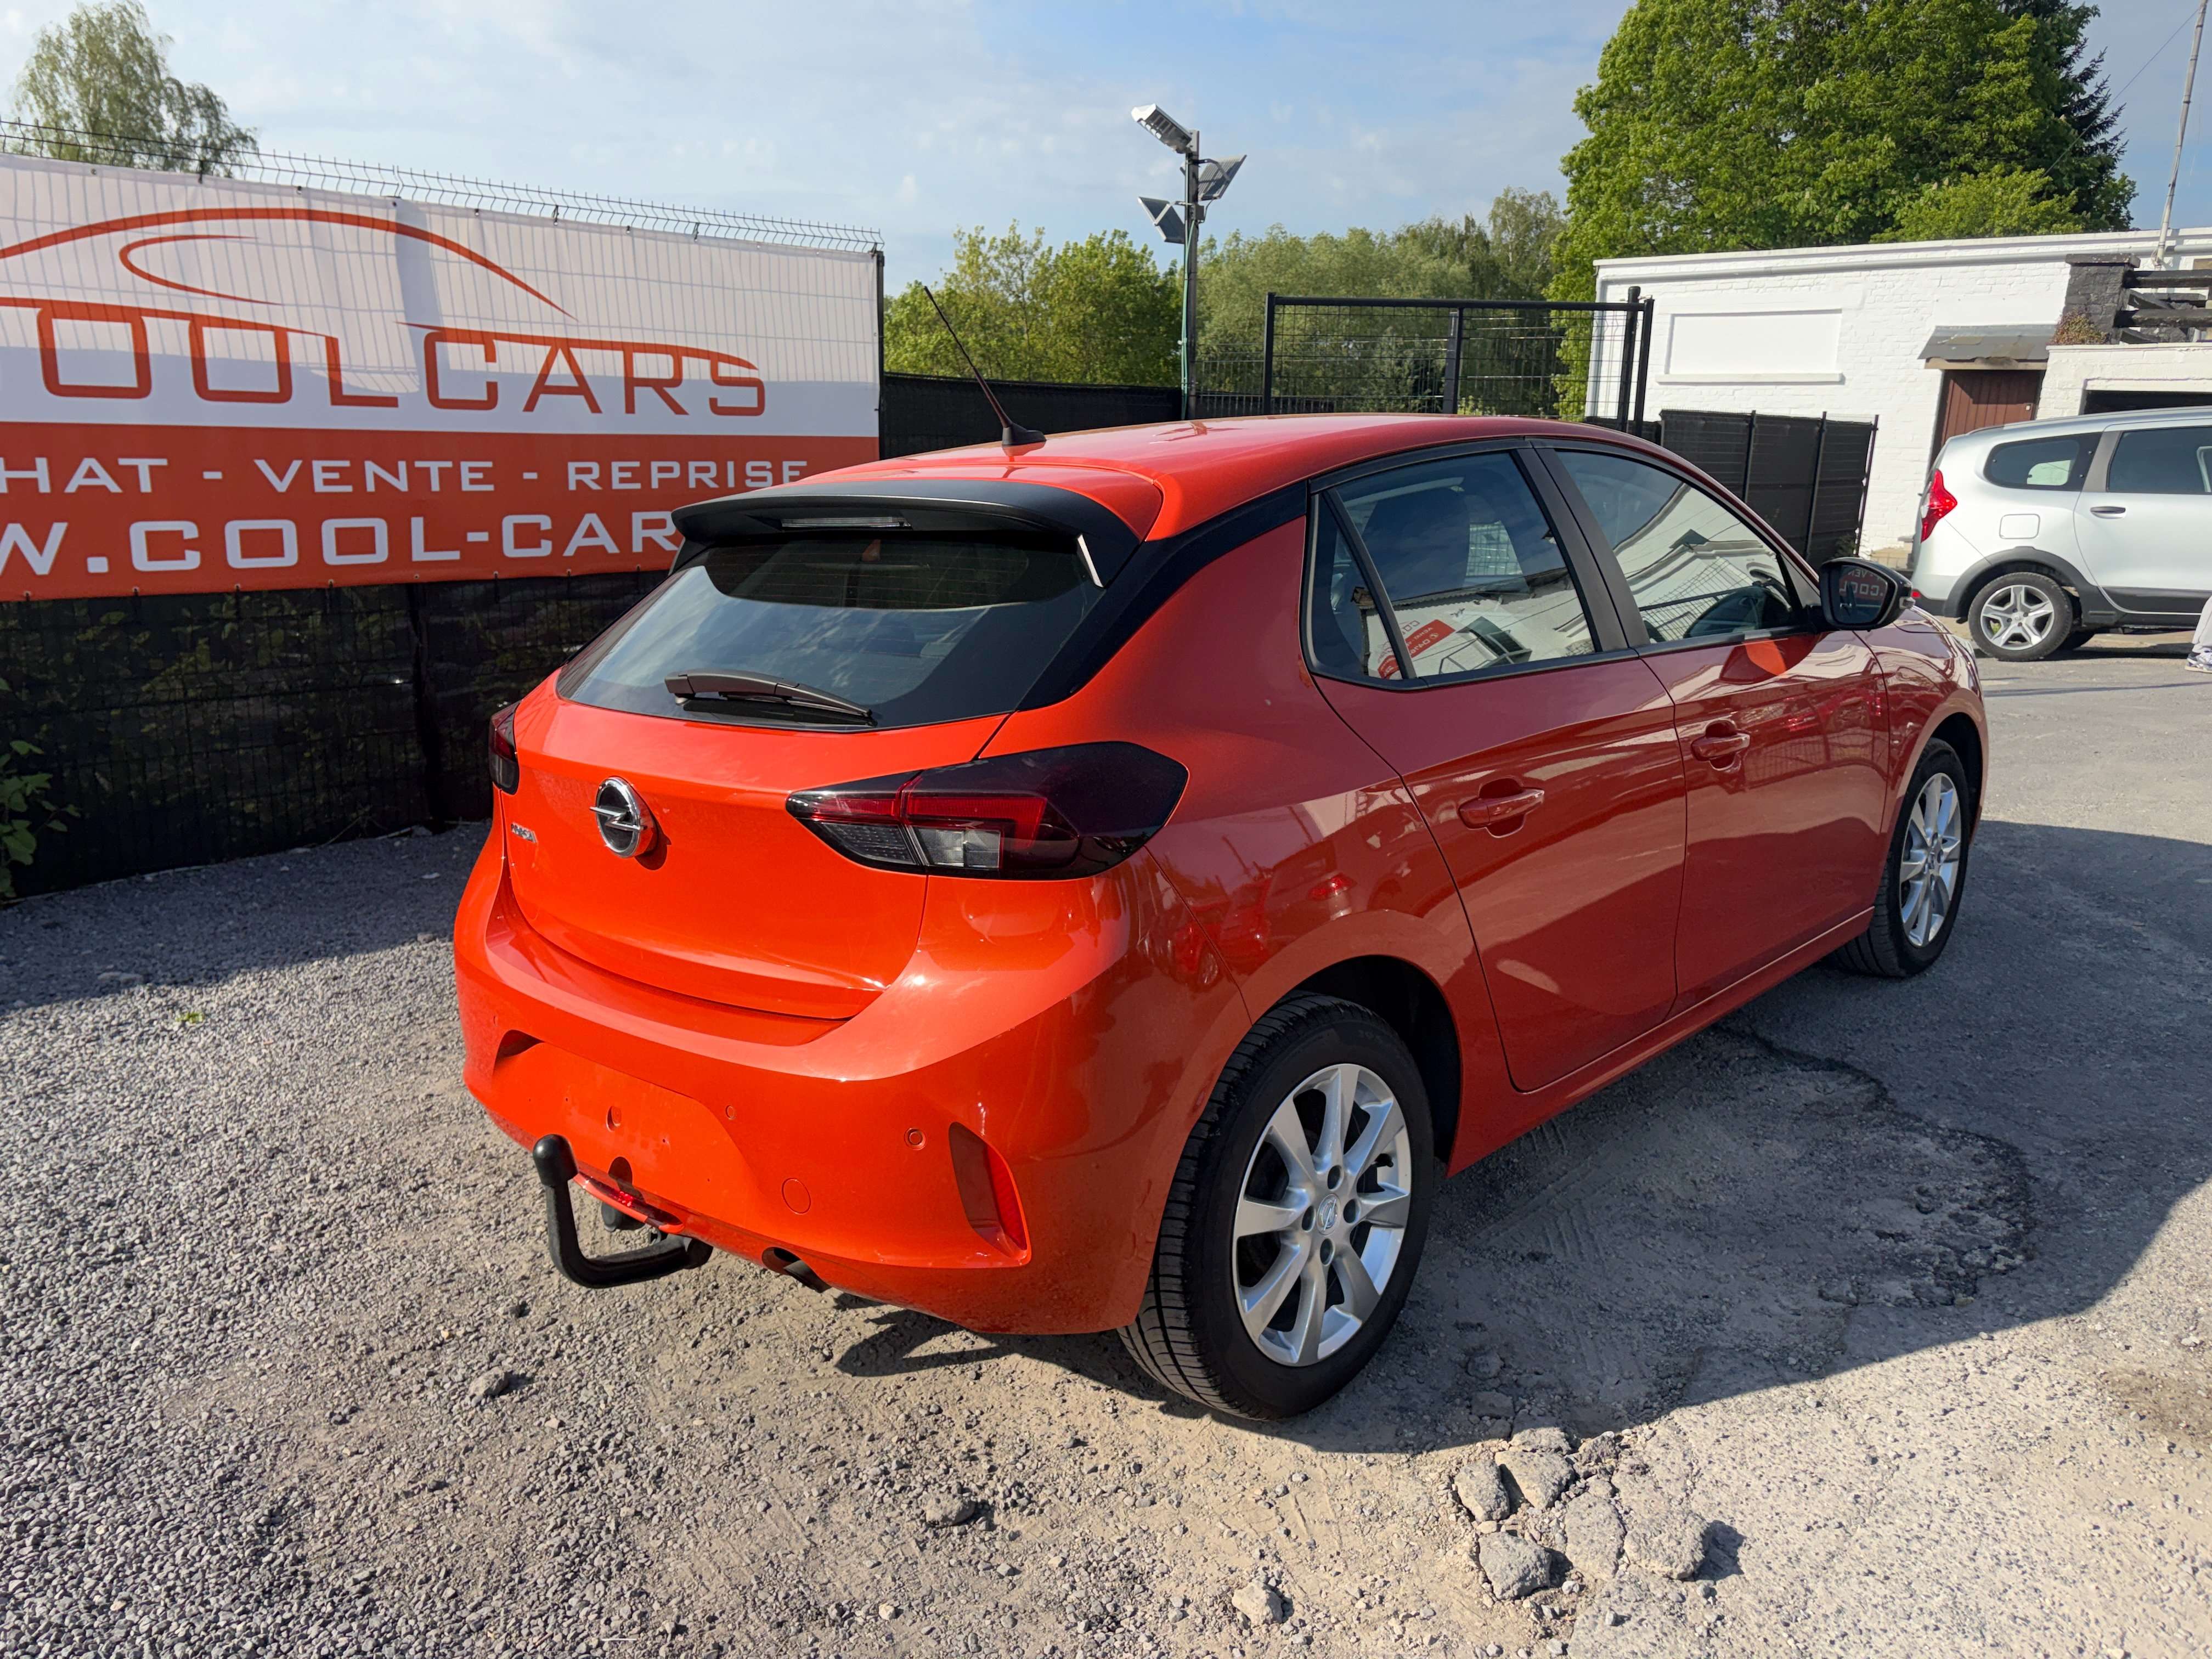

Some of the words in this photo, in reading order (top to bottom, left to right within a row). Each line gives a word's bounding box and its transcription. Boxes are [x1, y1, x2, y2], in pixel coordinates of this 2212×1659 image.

[0, 297, 399, 408] OOL
[421, 324, 766, 417] CARS
[253, 459, 495, 493] VENTE
[567, 460, 808, 492] REPRISE
